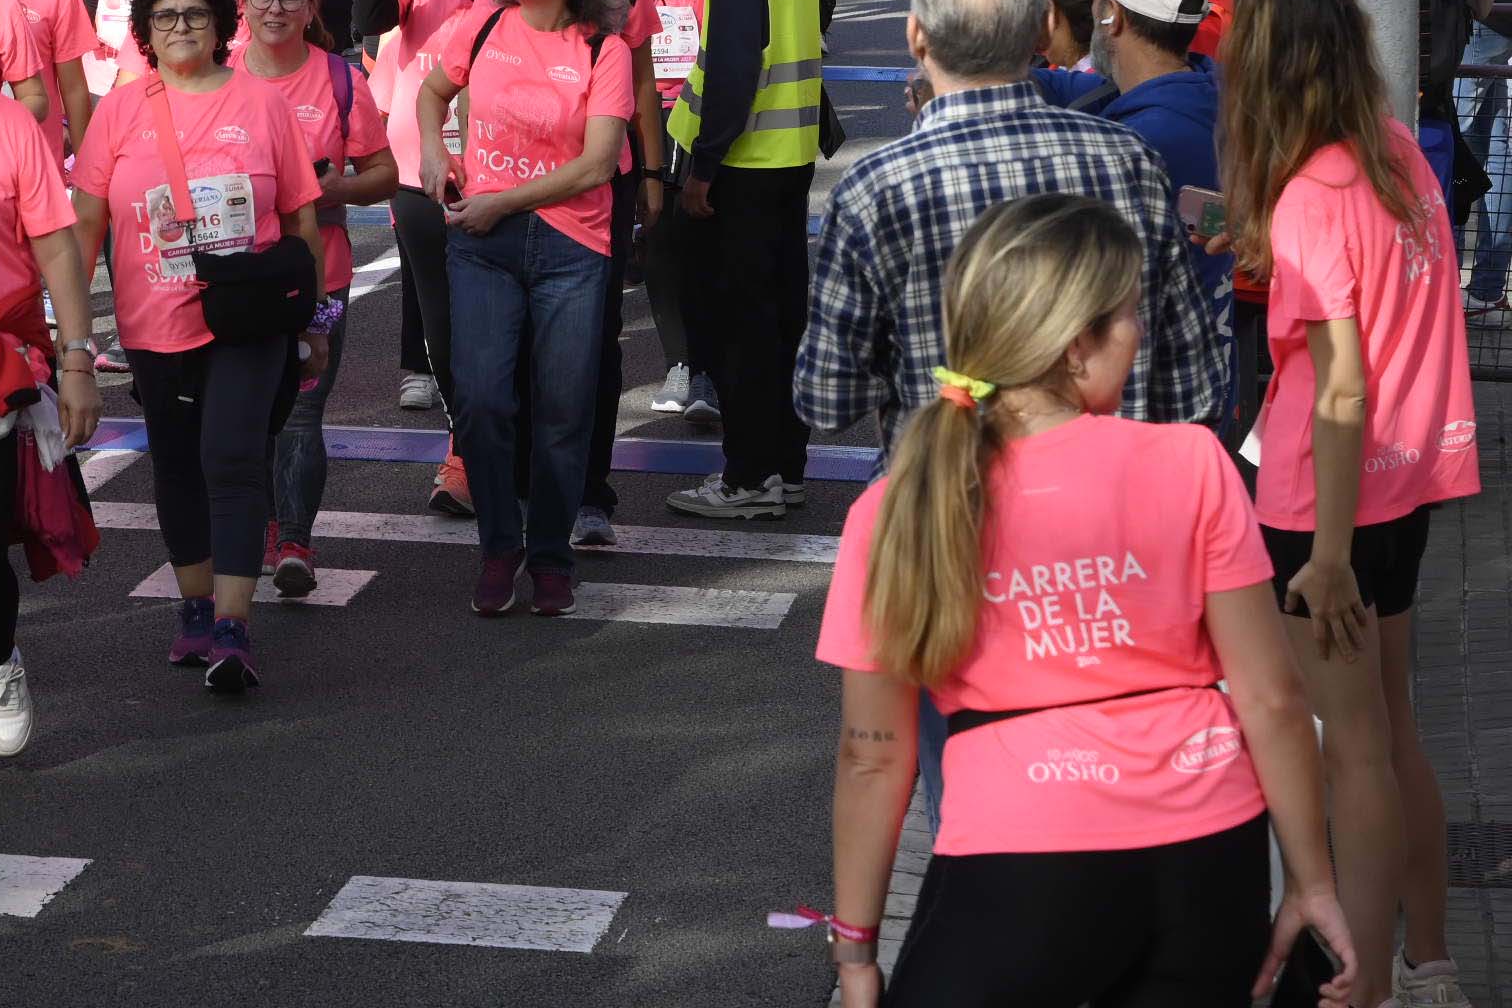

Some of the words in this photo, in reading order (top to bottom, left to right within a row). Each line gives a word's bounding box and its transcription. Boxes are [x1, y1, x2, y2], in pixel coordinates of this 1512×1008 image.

[486, 49, 522, 65] OYSHO
[1364, 448, 1420, 474] OYSHO
[983, 552, 1148, 603] CARRERA
[1018, 595, 1064, 630] DE
[1075, 589, 1123, 621] LA
[1025, 618, 1136, 661] MUJER
[1028, 761, 1119, 785] OYSHO
